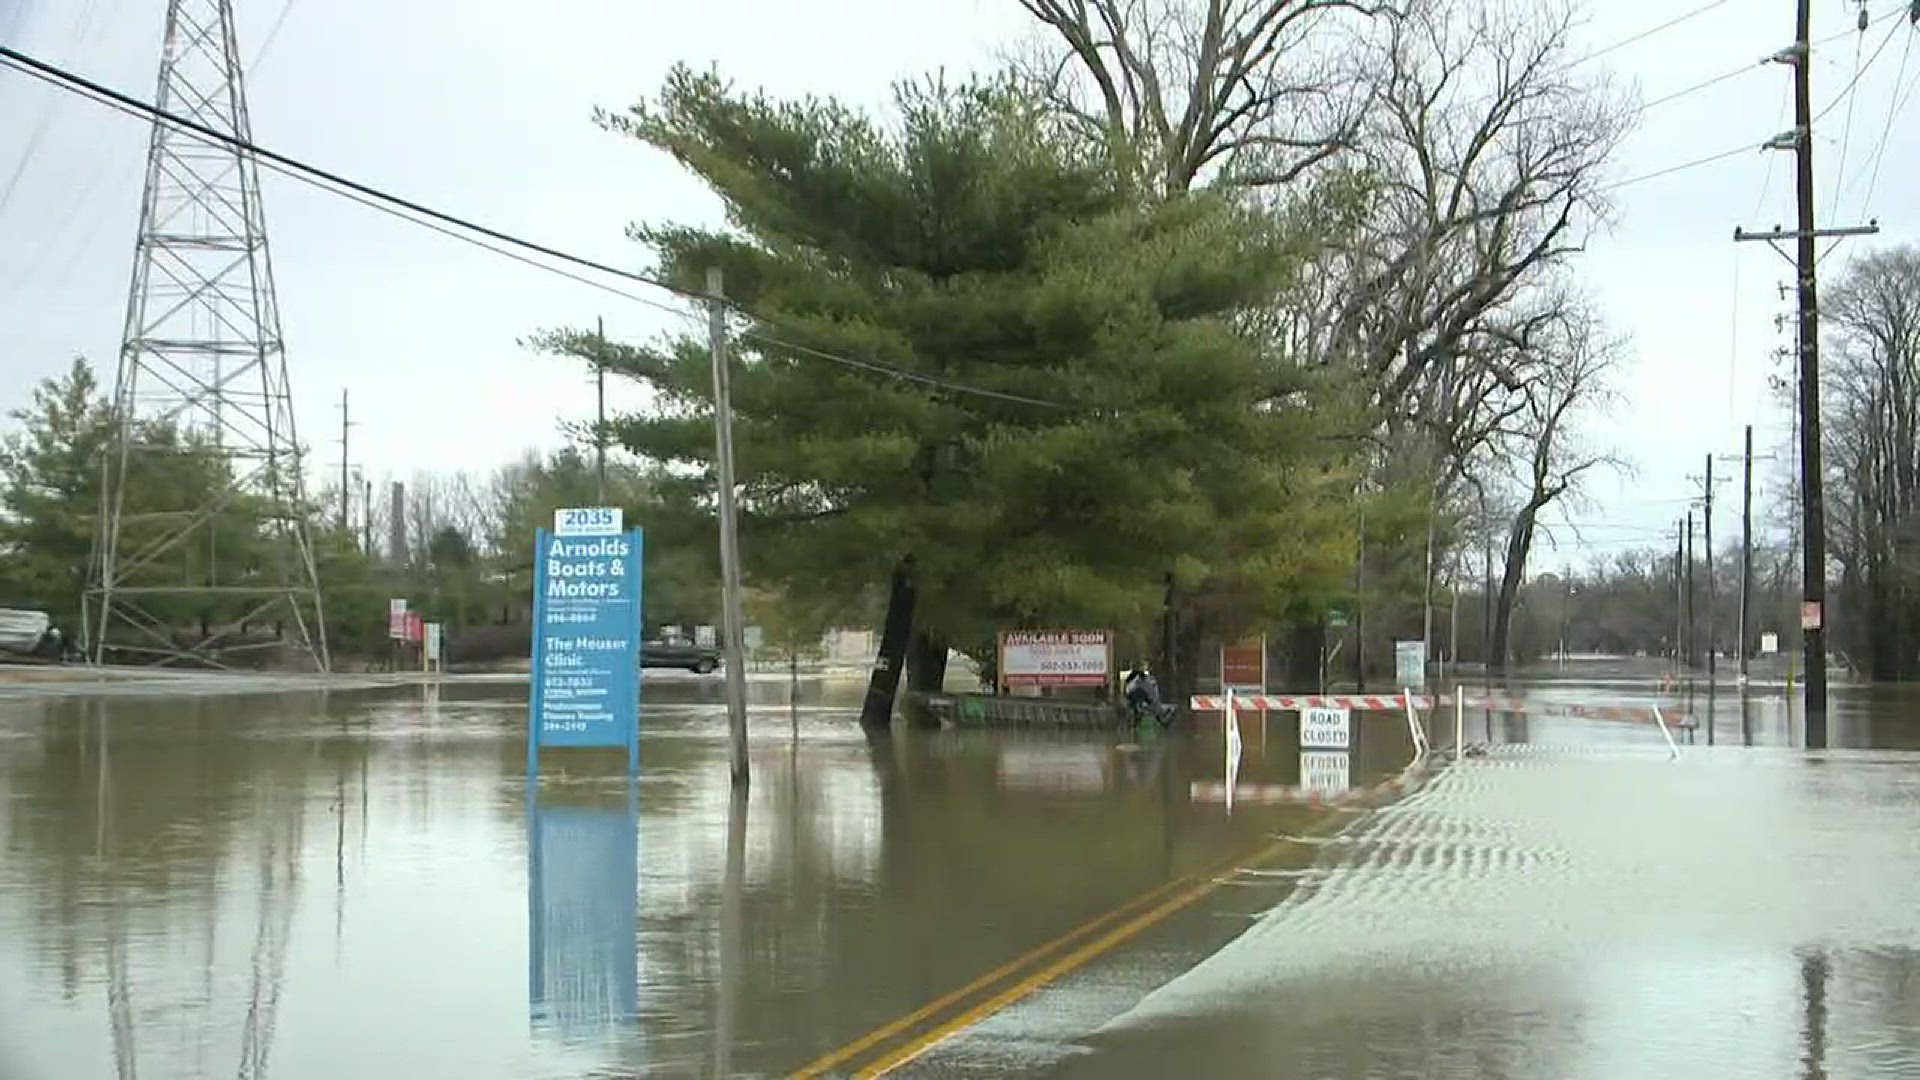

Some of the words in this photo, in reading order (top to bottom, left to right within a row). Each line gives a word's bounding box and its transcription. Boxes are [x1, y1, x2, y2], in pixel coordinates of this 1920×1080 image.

[565, 511, 613, 525] 2035
[549, 538, 629, 557] Arnolds
[548, 559, 606, 576] Boats
[611, 559, 625, 576] &
[548, 580, 620, 597] Motors
[546, 637, 573, 650] The
[1006, 633, 1066, 644] AVAILABLE
[545, 653, 583, 666] Clinic
[1309, 712, 1341, 725] ROAD
[1303, 730, 1347, 743] CLOSED
